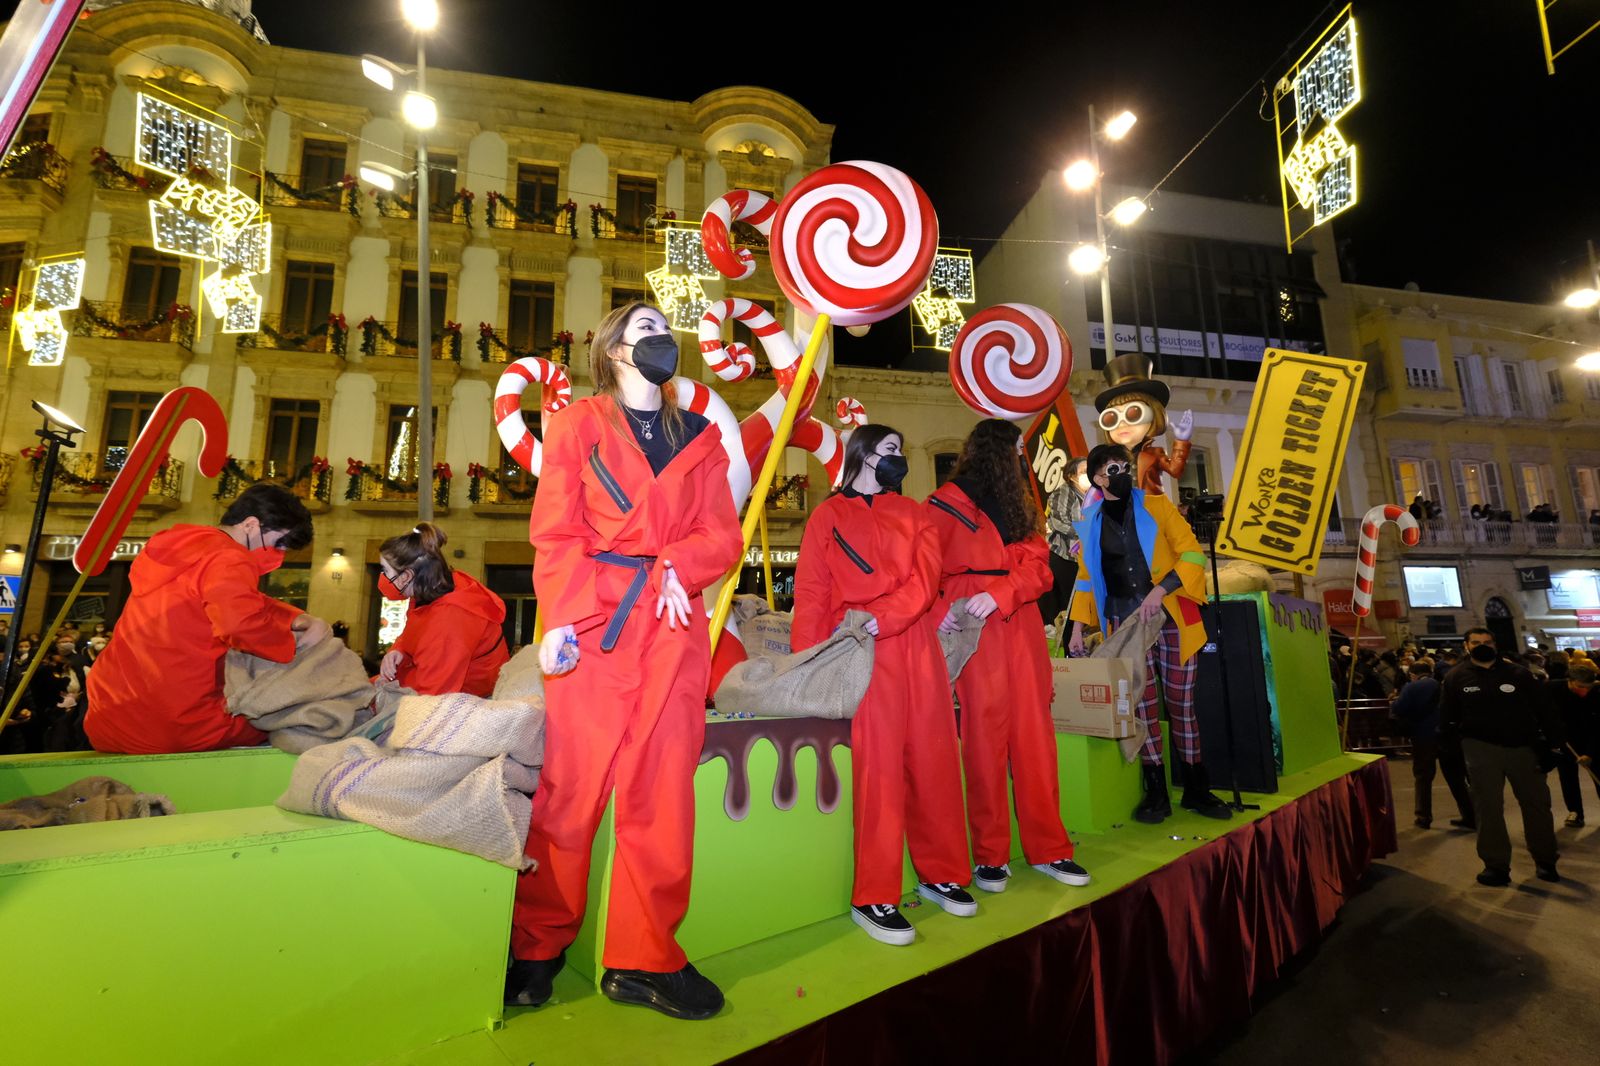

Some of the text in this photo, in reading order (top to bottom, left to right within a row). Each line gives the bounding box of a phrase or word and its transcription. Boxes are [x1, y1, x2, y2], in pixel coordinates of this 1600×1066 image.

[1224, 342, 1265, 354] BOGADOS
[1260, 369, 1338, 554] GOLDEN TICKET
[1327, 601, 1353, 614] Halco
